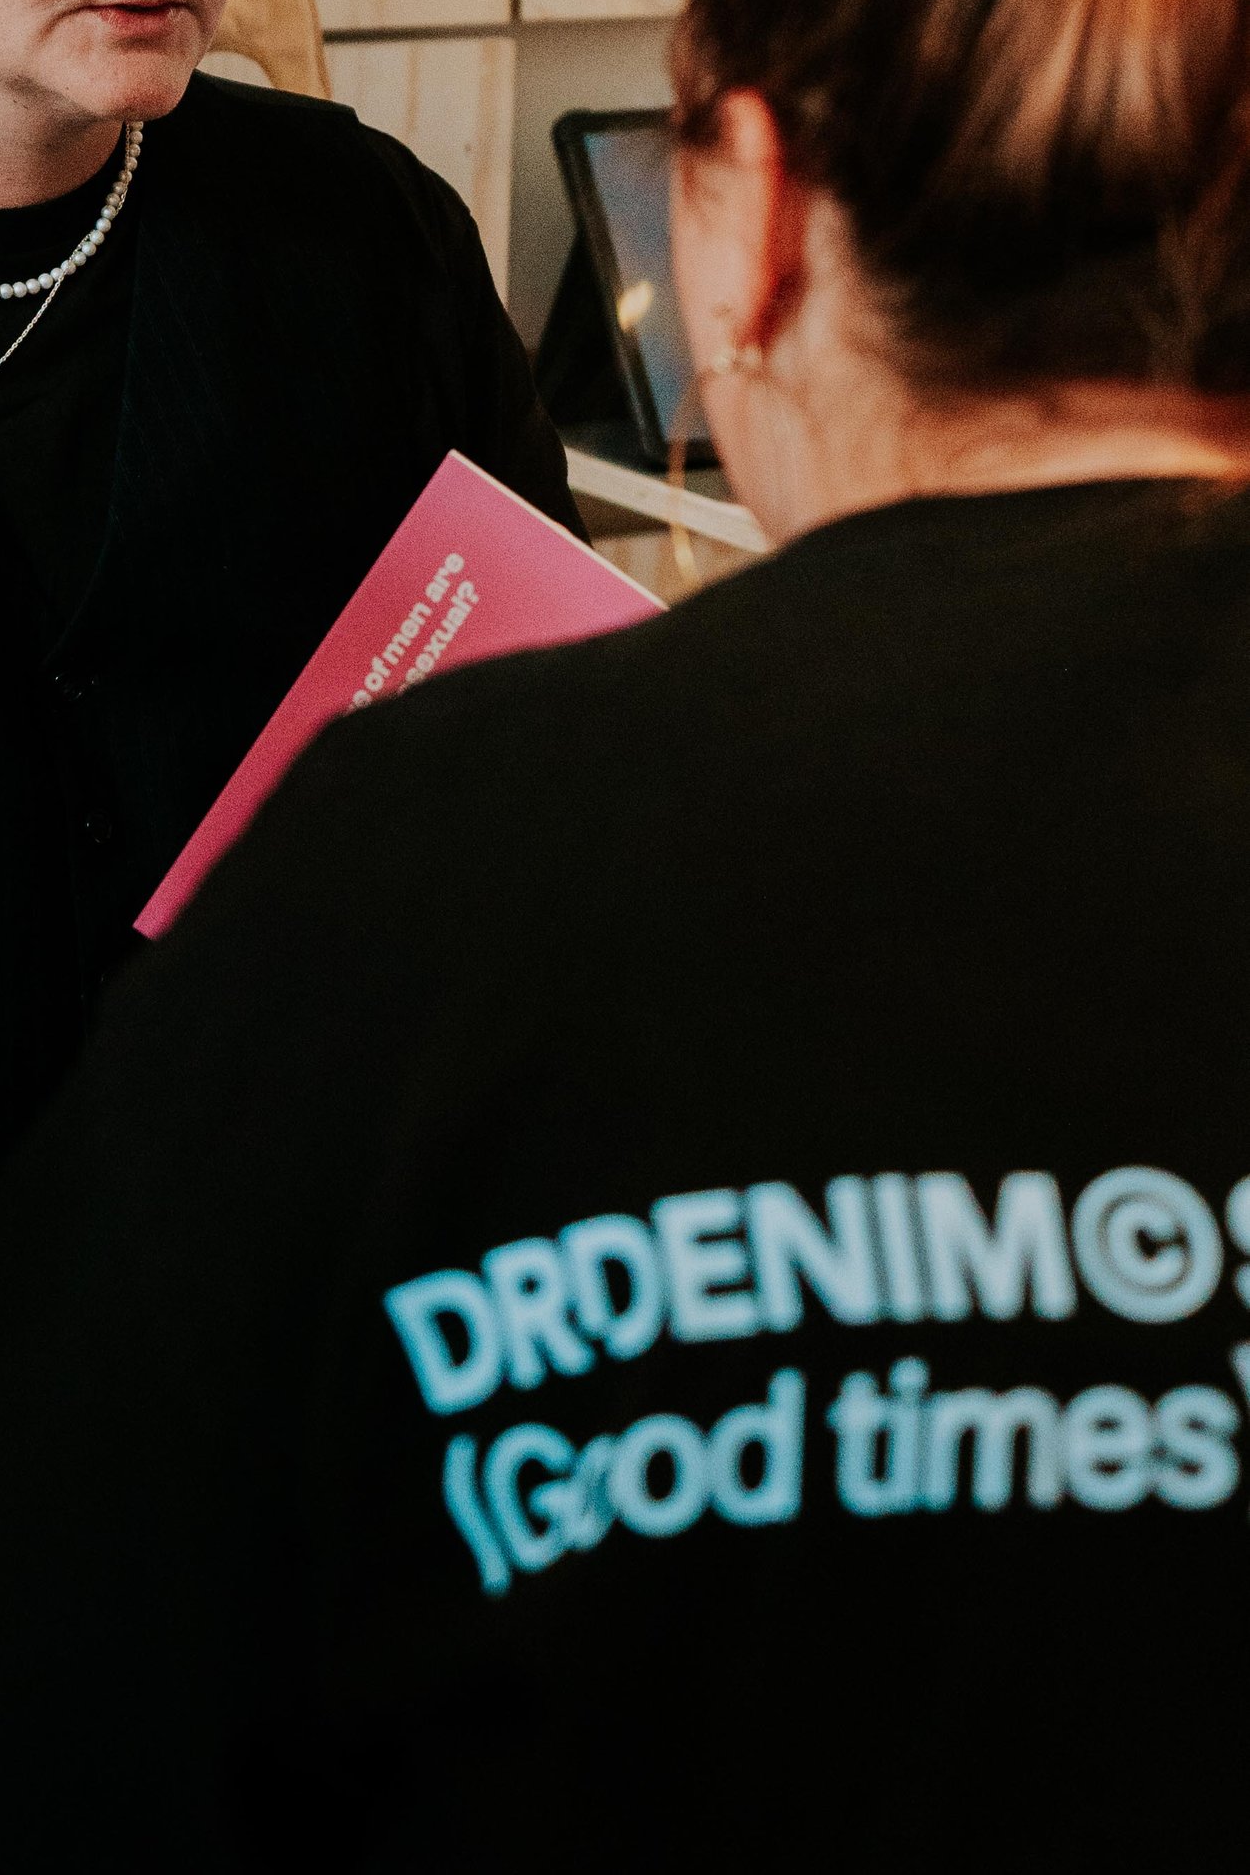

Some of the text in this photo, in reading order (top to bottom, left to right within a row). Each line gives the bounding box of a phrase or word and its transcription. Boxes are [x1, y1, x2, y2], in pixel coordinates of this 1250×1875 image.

[364, 552, 465, 692] of men are
[398, 580, 479, 692] sexual?
[826, 1339, 1250, 1518] times
